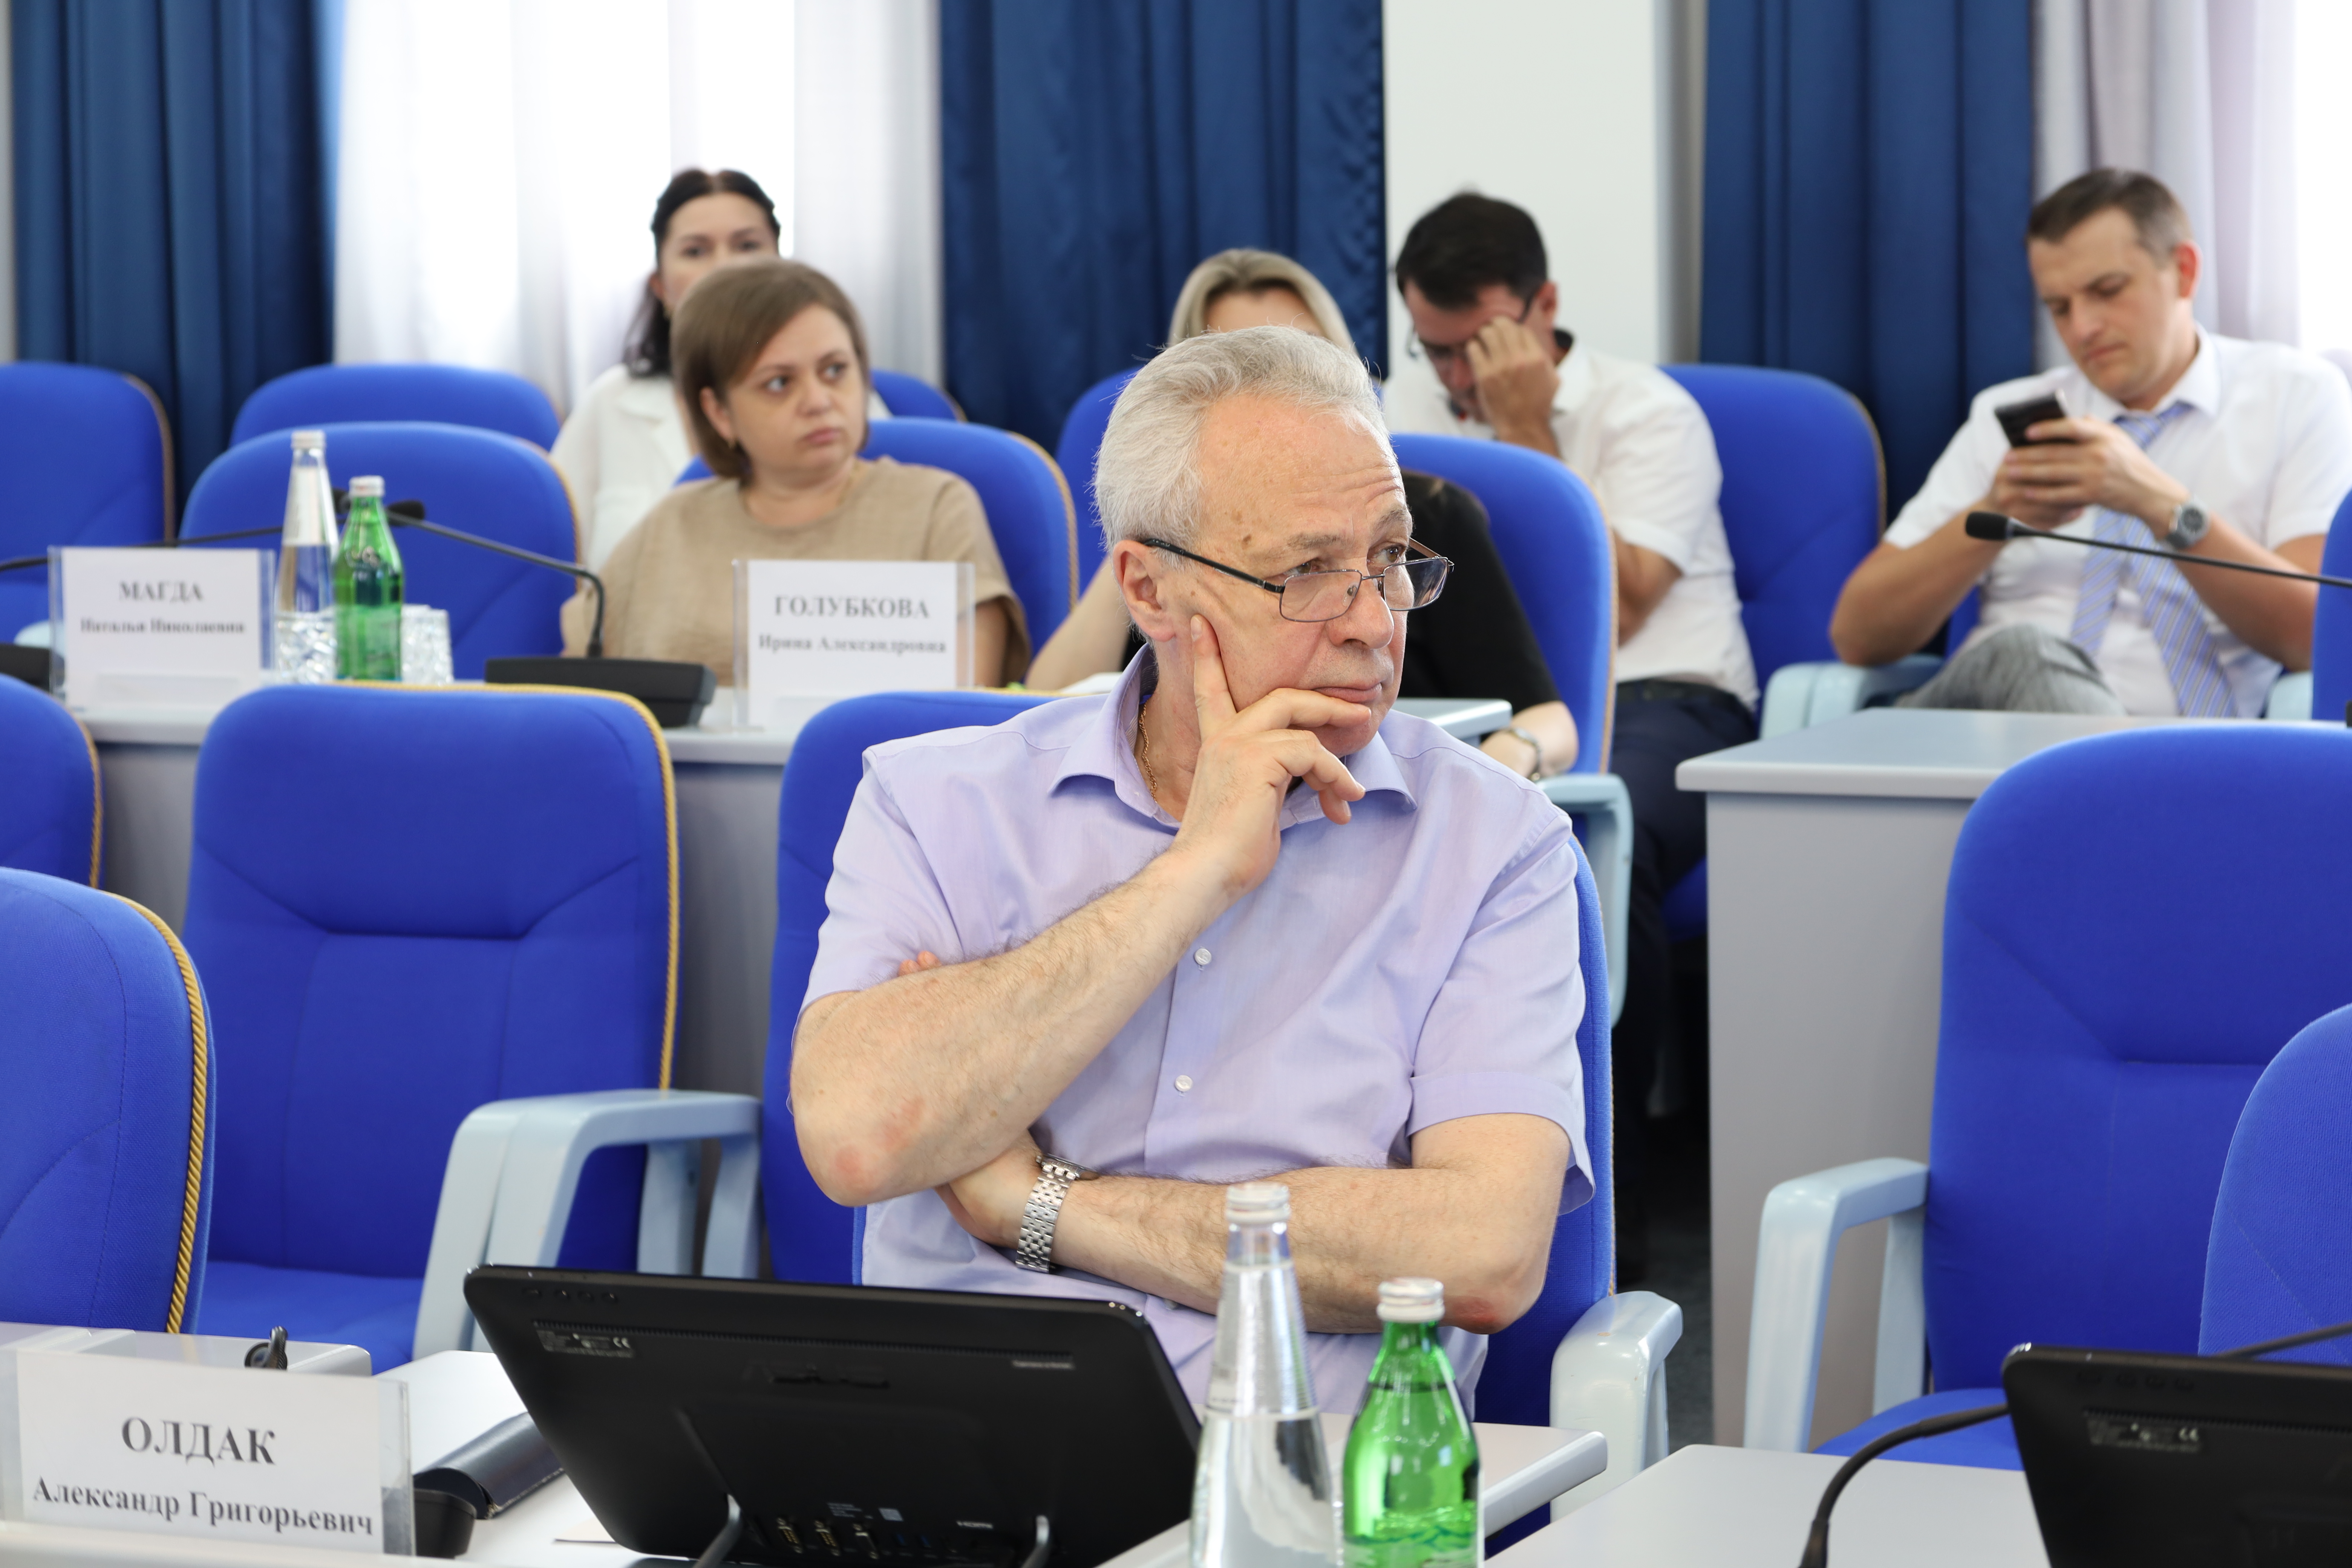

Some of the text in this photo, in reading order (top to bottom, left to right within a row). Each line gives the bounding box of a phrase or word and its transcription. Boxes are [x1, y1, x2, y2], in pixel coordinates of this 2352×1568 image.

[119, 581, 203, 604] МАГДА
[775, 595, 929, 619] ГОЛУБКОВА
[81, 617, 245, 634] Наталья Николаевна
[759, 634, 946, 657] Ирина Александровна
[121, 1416, 276, 1467] ОЛДАК
[32, 1476, 374, 1536] Александр Григорьевич
